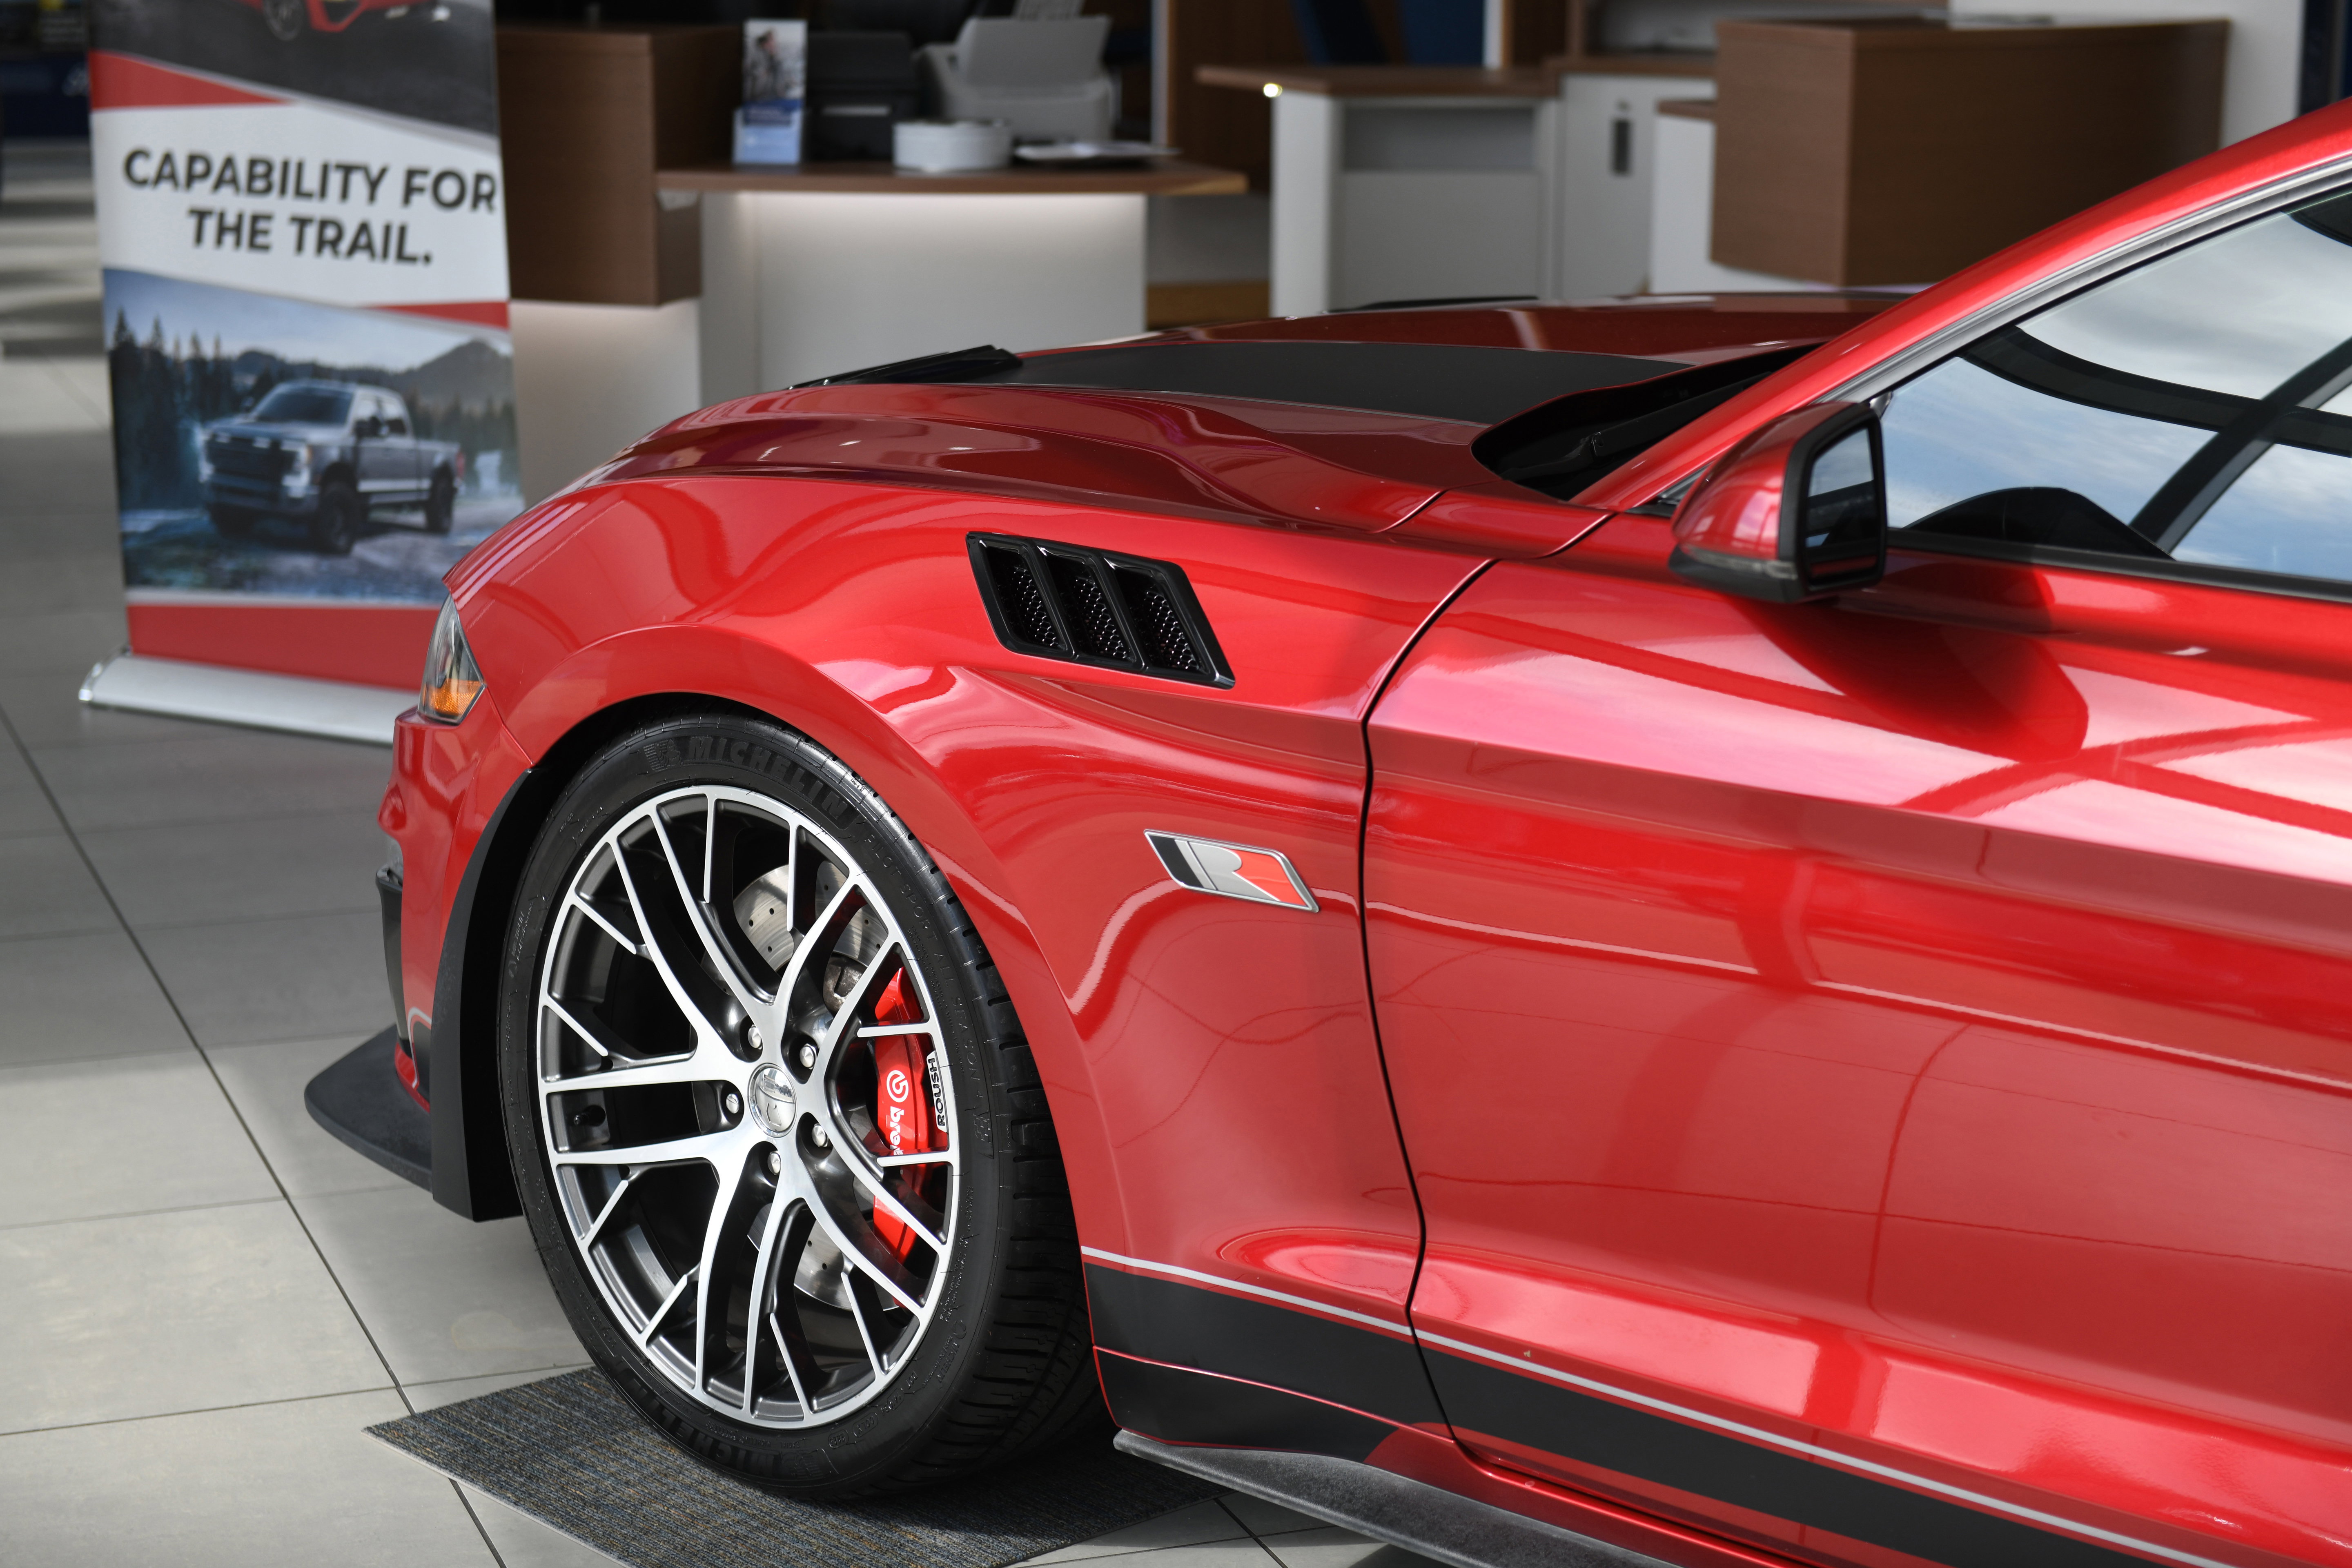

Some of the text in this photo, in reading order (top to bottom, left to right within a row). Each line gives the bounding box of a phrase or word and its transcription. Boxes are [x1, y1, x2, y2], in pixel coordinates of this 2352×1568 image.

[124, 149, 497, 212] CAPABILITY FOR
[188, 207, 433, 265] THE TRAIL.
[688, 736, 849, 821] MICHELIN
[864, 832, 902, 878] PILOT
[901, 882, 938, 942] SPORT
[933, 951, 955, 988] ALL
[951, 994, 980, 1081] SEASON
[928, 1058, 945, 1126] ROUSH
[890, 1106, 904, 1155] bre
[906, 1370, 919, 1387] DOT
[937, 1341, 960, 1383] MICHELIN
